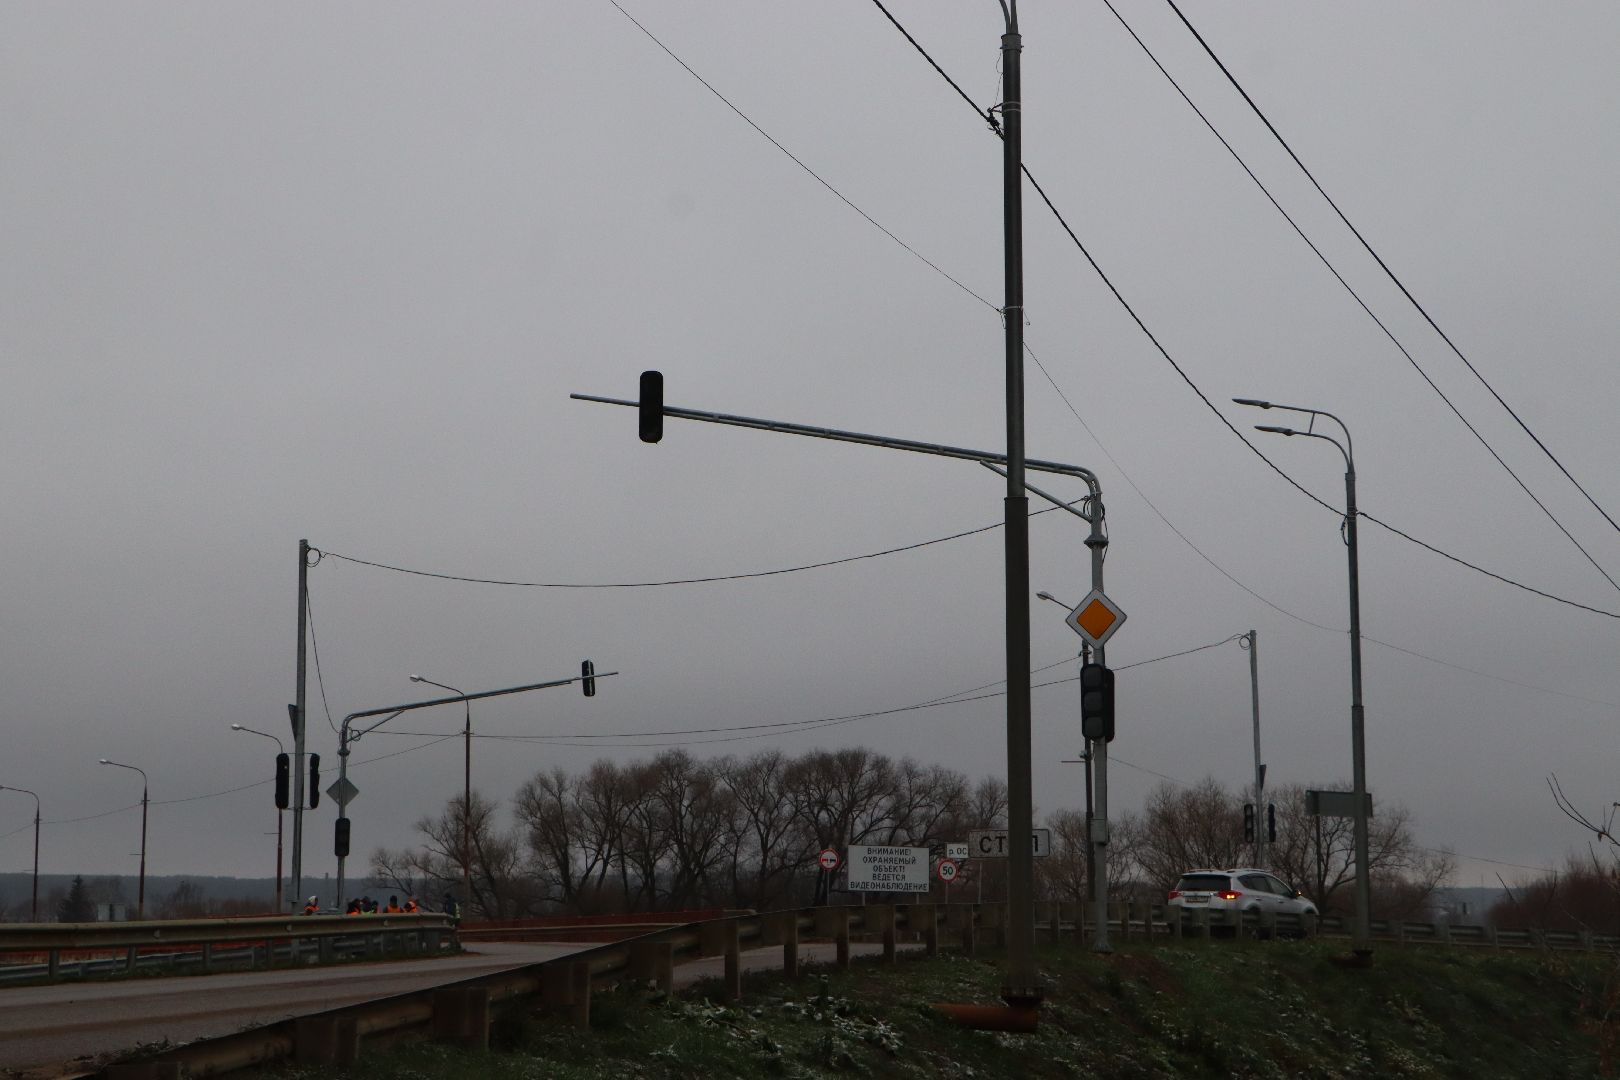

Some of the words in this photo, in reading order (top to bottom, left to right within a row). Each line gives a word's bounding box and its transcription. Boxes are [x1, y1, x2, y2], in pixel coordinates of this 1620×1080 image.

[867, 848, 911, 856] ВНИМАНИЕ!
[862, 856, 916, 865] ОХРАНЯЕМЫЙ
[872, 865, 905, 873] ОБЪЕКТ!
[942, 866, 954, 876] 50
[850, 881, 928, 891] ВИДЕОНАБЛЮДЕНИЕ
